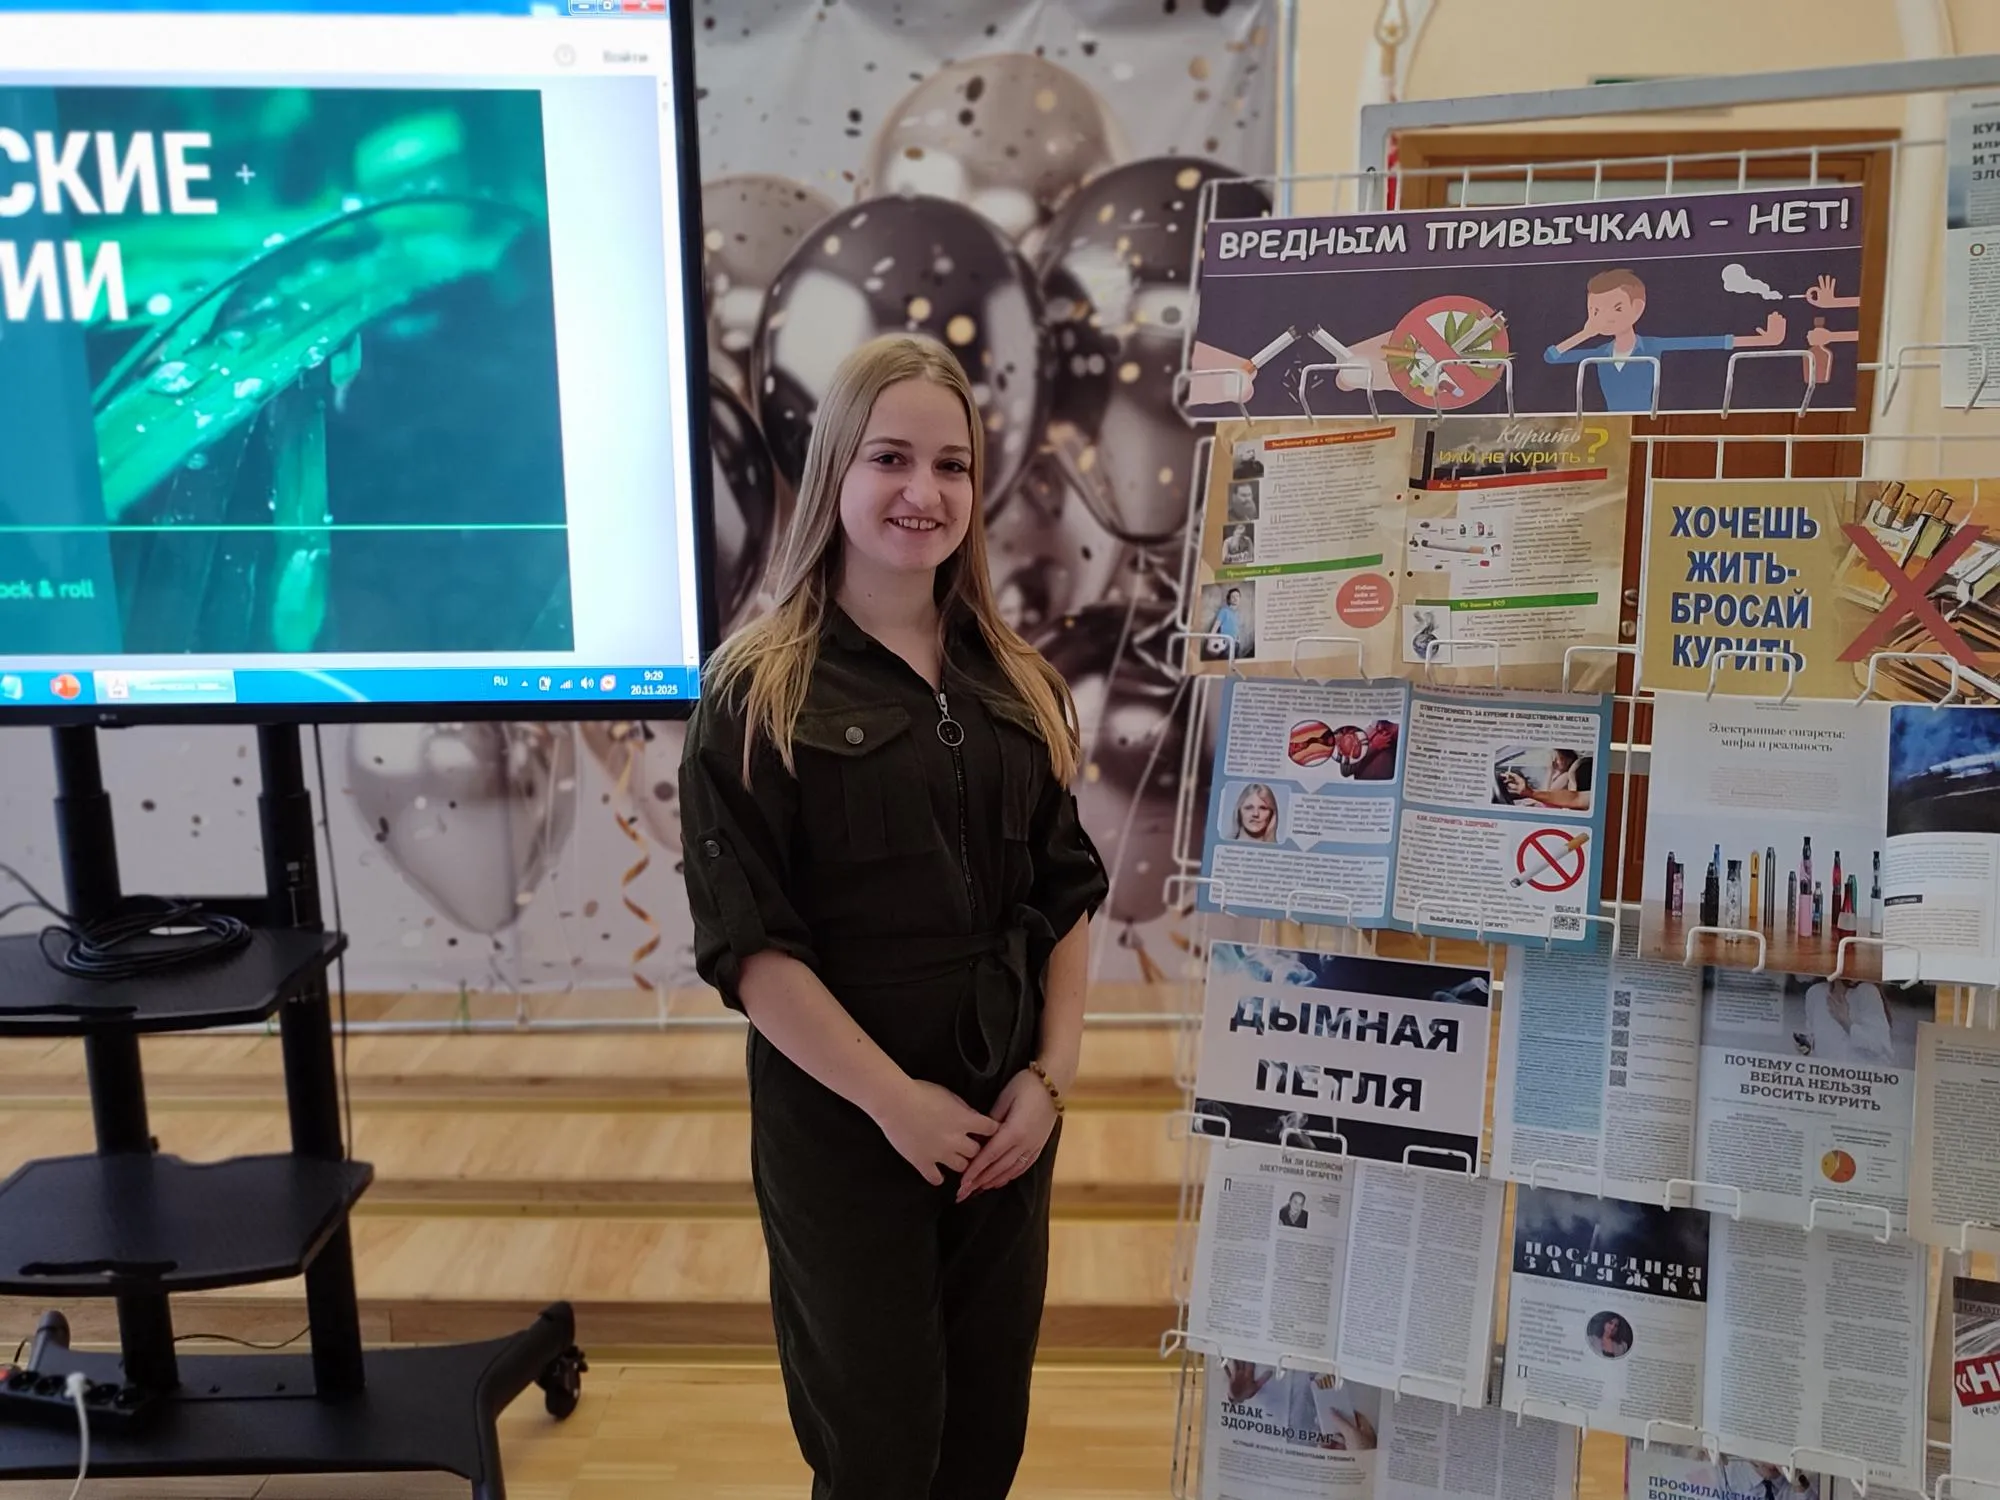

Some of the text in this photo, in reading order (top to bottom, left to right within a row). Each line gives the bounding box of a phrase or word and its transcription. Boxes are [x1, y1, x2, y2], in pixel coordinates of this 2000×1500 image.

[1973, 121, 2000, 135] КУ
[0, 127, 218, 217] СКИЕ
[1218, 224, 1407, 262] ВРЕДНЫМ
[1424, 208, 1692, 251] ПРИВЫЧКАМ
[1748, 197, 1850, 236] НЕТ!
[1496, 424, 1582, 449] Курить
[1481, 450, 1505, 464] не
[1509, 450, 1582, 467] курить
[1669, 505, 1820, 540] ХОЧЕШЬ
[1685, 550, 1799, 585] ЖИТЬ-
[38, 579, 54, 598] &
[59, 579, 95, 598] roll
[1670, 588, 1812, 629] БРОСАЙ
[1671, 634, 1807, 673] КУРИТЬ
[493, 676, 509, 687] RU
[630, 685, 679, 696] 20.11.2025
[643, 671, 664, 681] 9:29
[1708, 721, 1787, 737] Электронные
[1720, 737, 1833, 752] мифы и реальность
[1229, 996, 1460, 1053] ДЫМНАЯ
[1724, 1054, 1899, 1086] ПОЧЕМУ С ПОМОЩЬЮ
[1750, 1070, 1872, 1096] ВЕЙПА НЕЛЬЗЯ
[1255, 1058, 1423, 1113] ПЕТЛЯ
[1739, 1083, 1815, 1104] БРОСИТЬ
[1818, 1093, 1881, 1112] КУРИТЬ
[1525, 1240, 1702, 1281] ПОСЛЕДНЯЯ
[1524, 1255, 1701, 1296] ЗАТЯЖКА
[1221, 1401, 1263, 1419] ТАБАК
[1221, 1415, 1334, 1444] ЗДОРОВЬЮ ВРАГ
